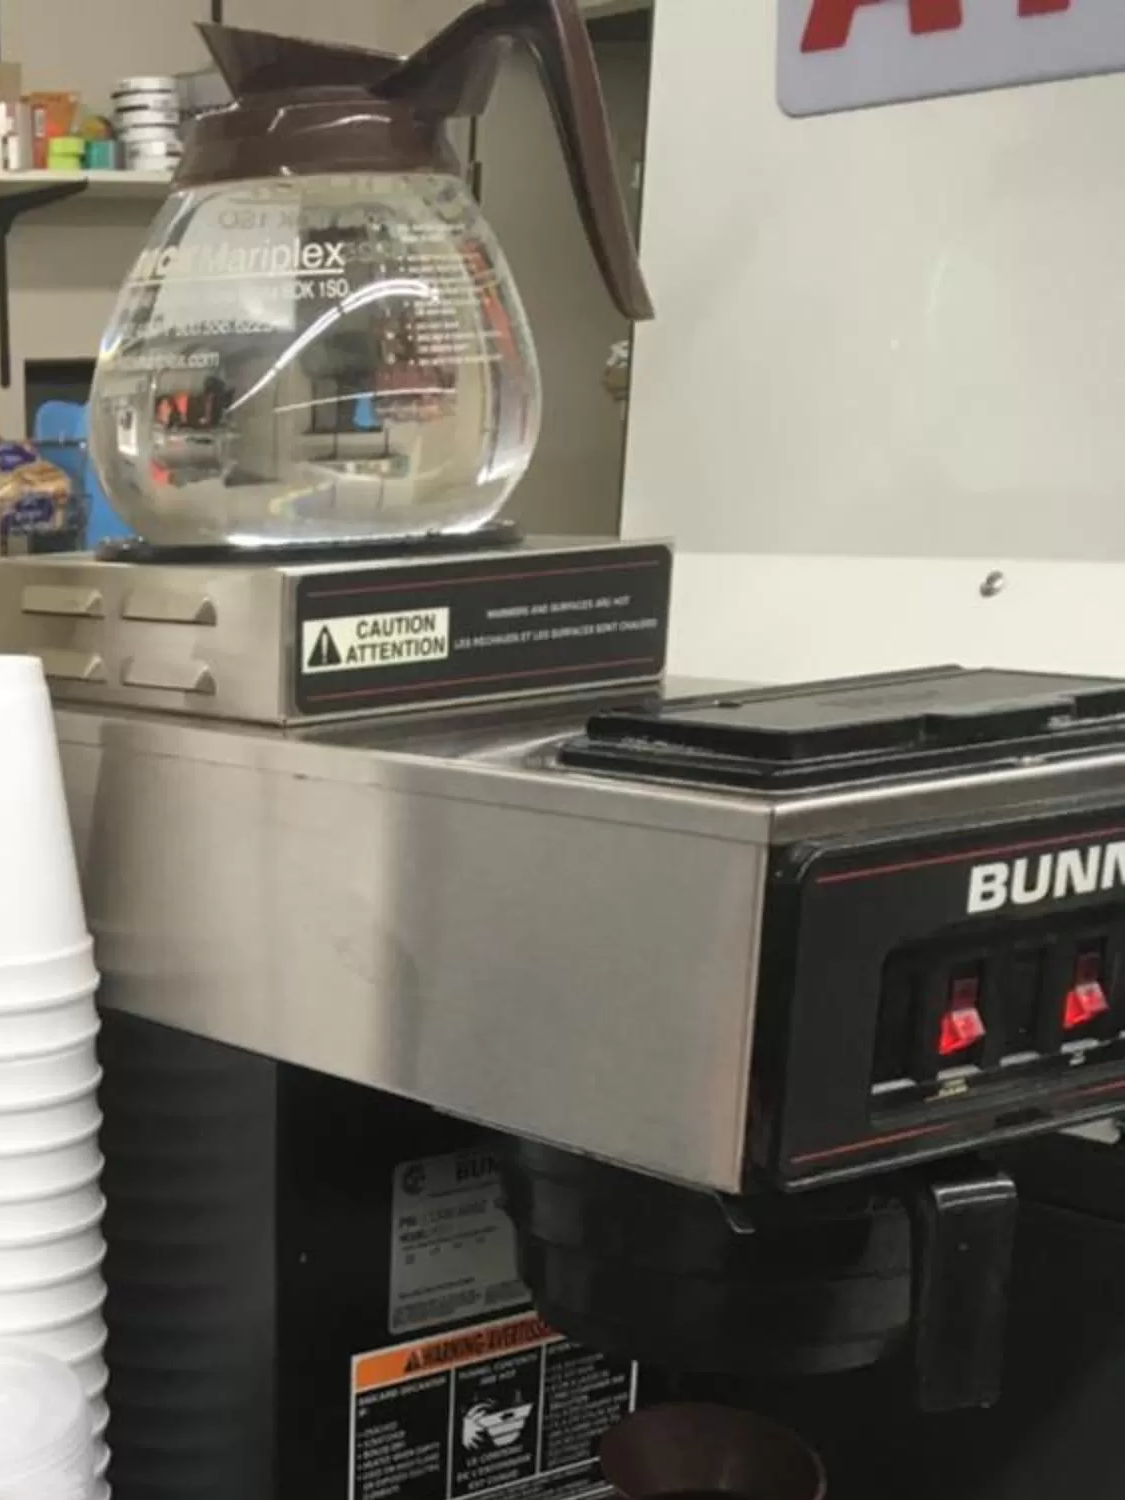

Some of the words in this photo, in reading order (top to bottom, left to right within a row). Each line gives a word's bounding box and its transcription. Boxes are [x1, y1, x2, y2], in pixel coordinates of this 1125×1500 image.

[355, 613, 437, 640] CAUTION
[346, 636, 445, 665] ATTENTION
[966, 840, 1125, 914] BUNN
